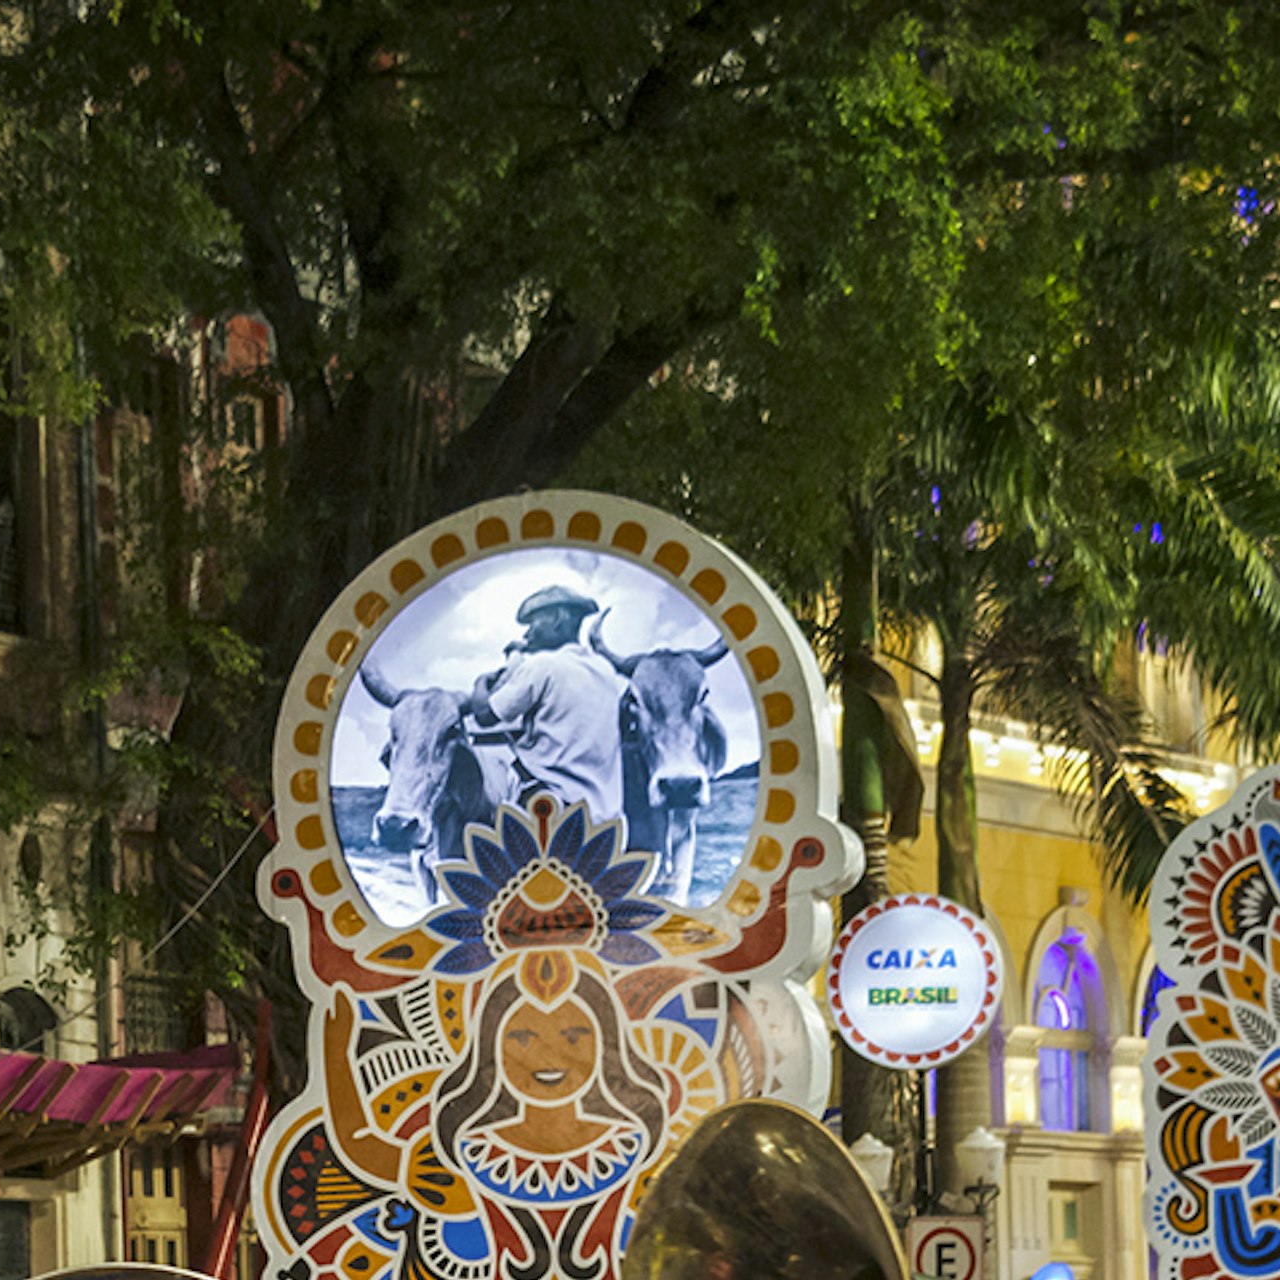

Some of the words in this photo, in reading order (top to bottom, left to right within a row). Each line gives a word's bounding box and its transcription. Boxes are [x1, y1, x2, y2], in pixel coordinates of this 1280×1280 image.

[866, 948, 958, 970] CAIXA
[868, 986, 958, 1006] BRASIL
[935, 1242, 957, 1279] E
